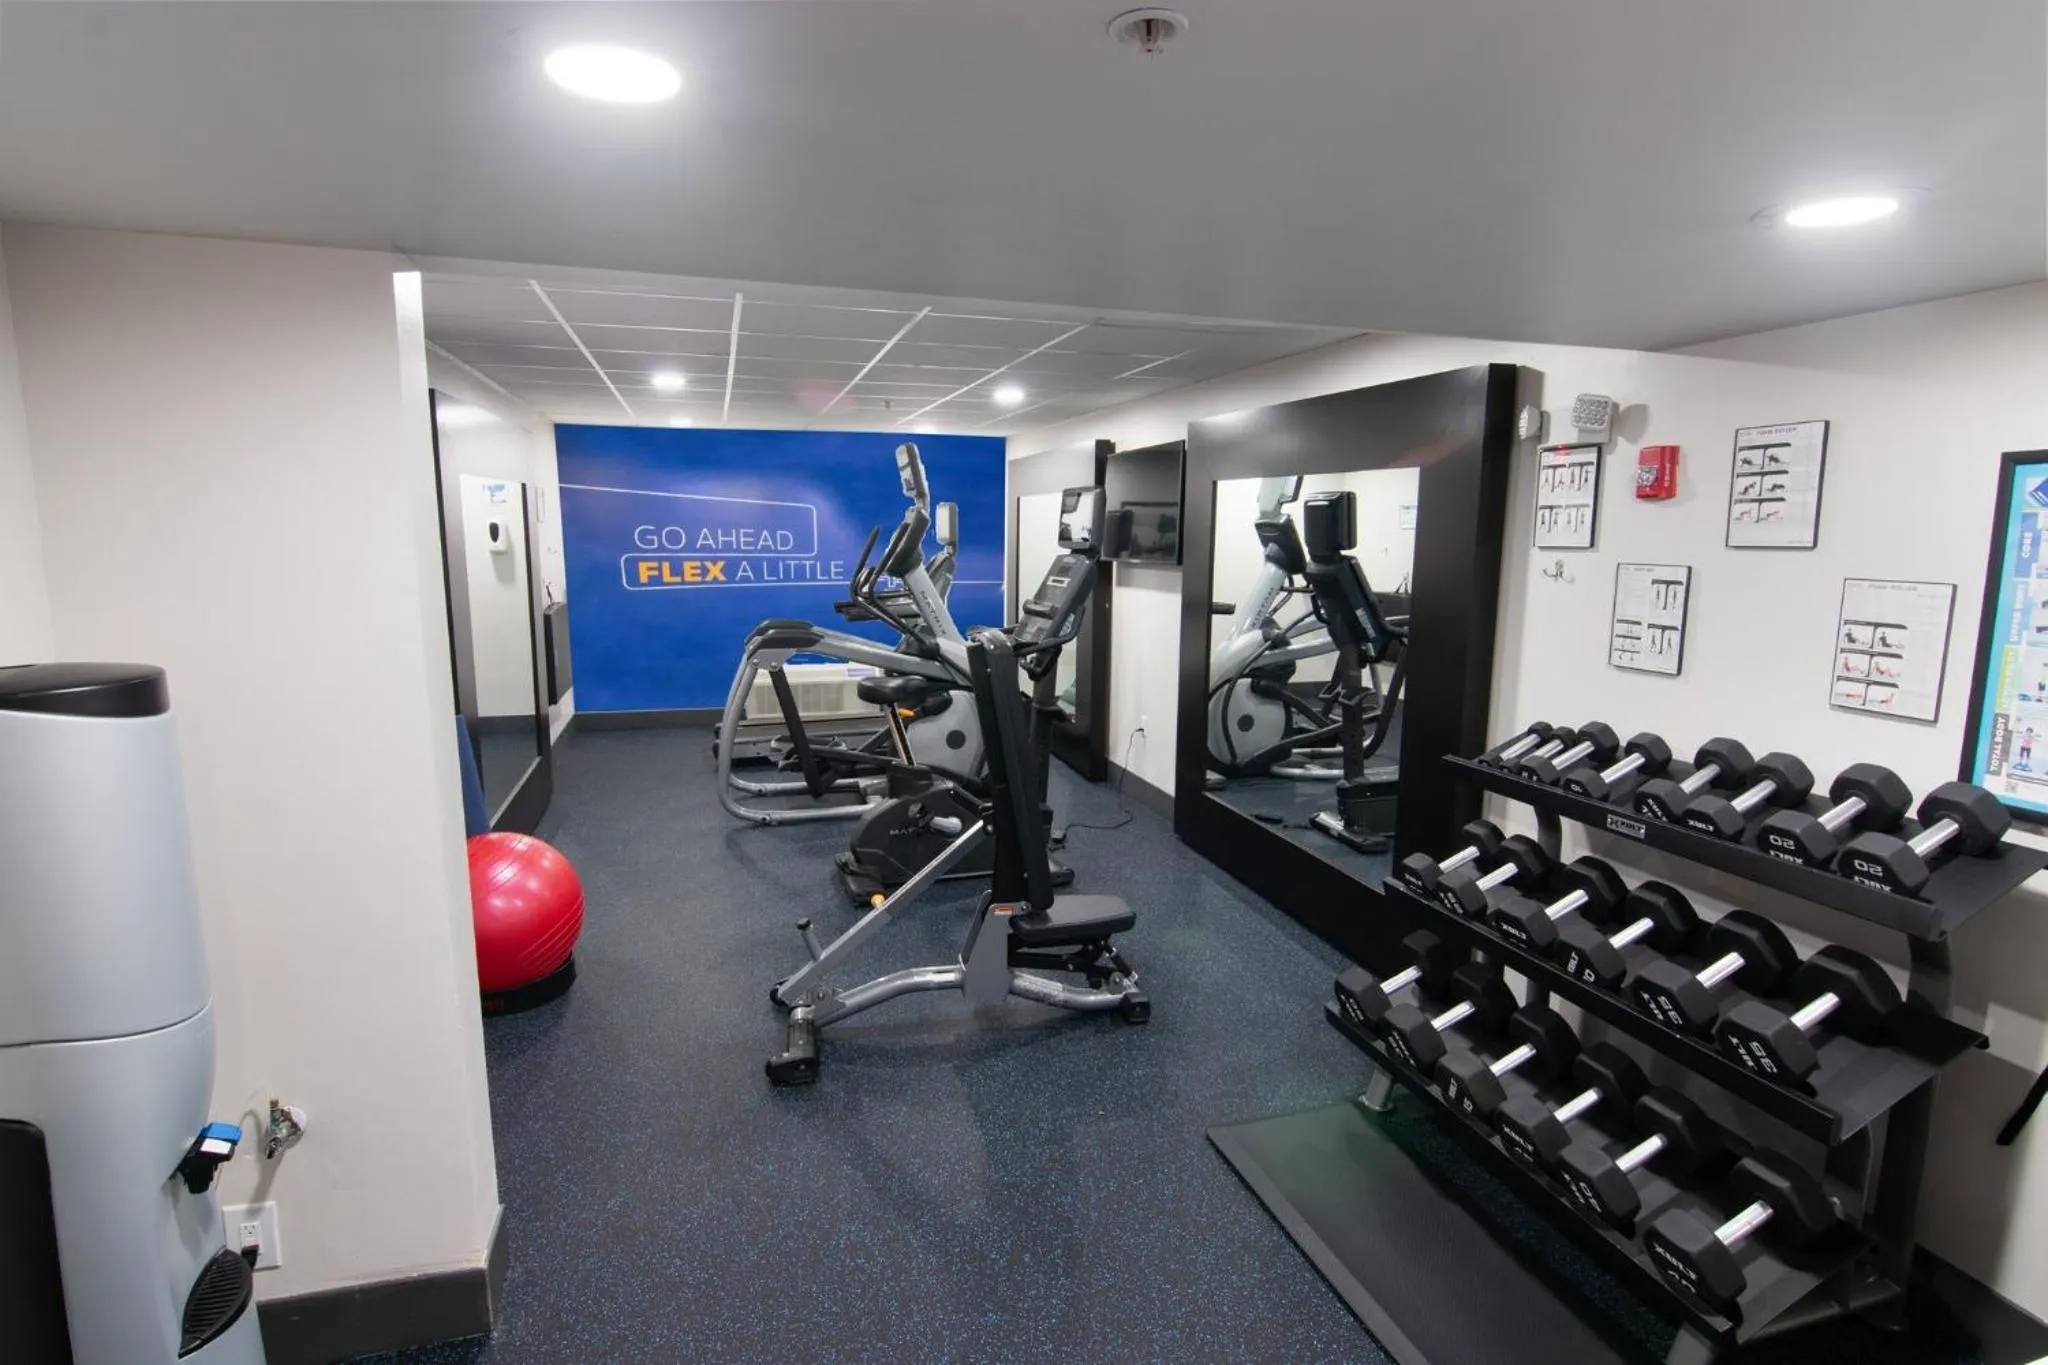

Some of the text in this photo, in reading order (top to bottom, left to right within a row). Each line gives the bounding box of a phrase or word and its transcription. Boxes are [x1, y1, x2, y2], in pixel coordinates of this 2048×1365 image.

[634, 525, 794, 551] GO AHEAD
[637, 560, 844, 584] FLEX A LITTLE
[1989, 717, 2007, 772] TOTAL BODY
[1768, 834, 1796, 850] 20
[1853, 858, 1884, 877] 20
[1749, 1041, 1779, 1075] 35
